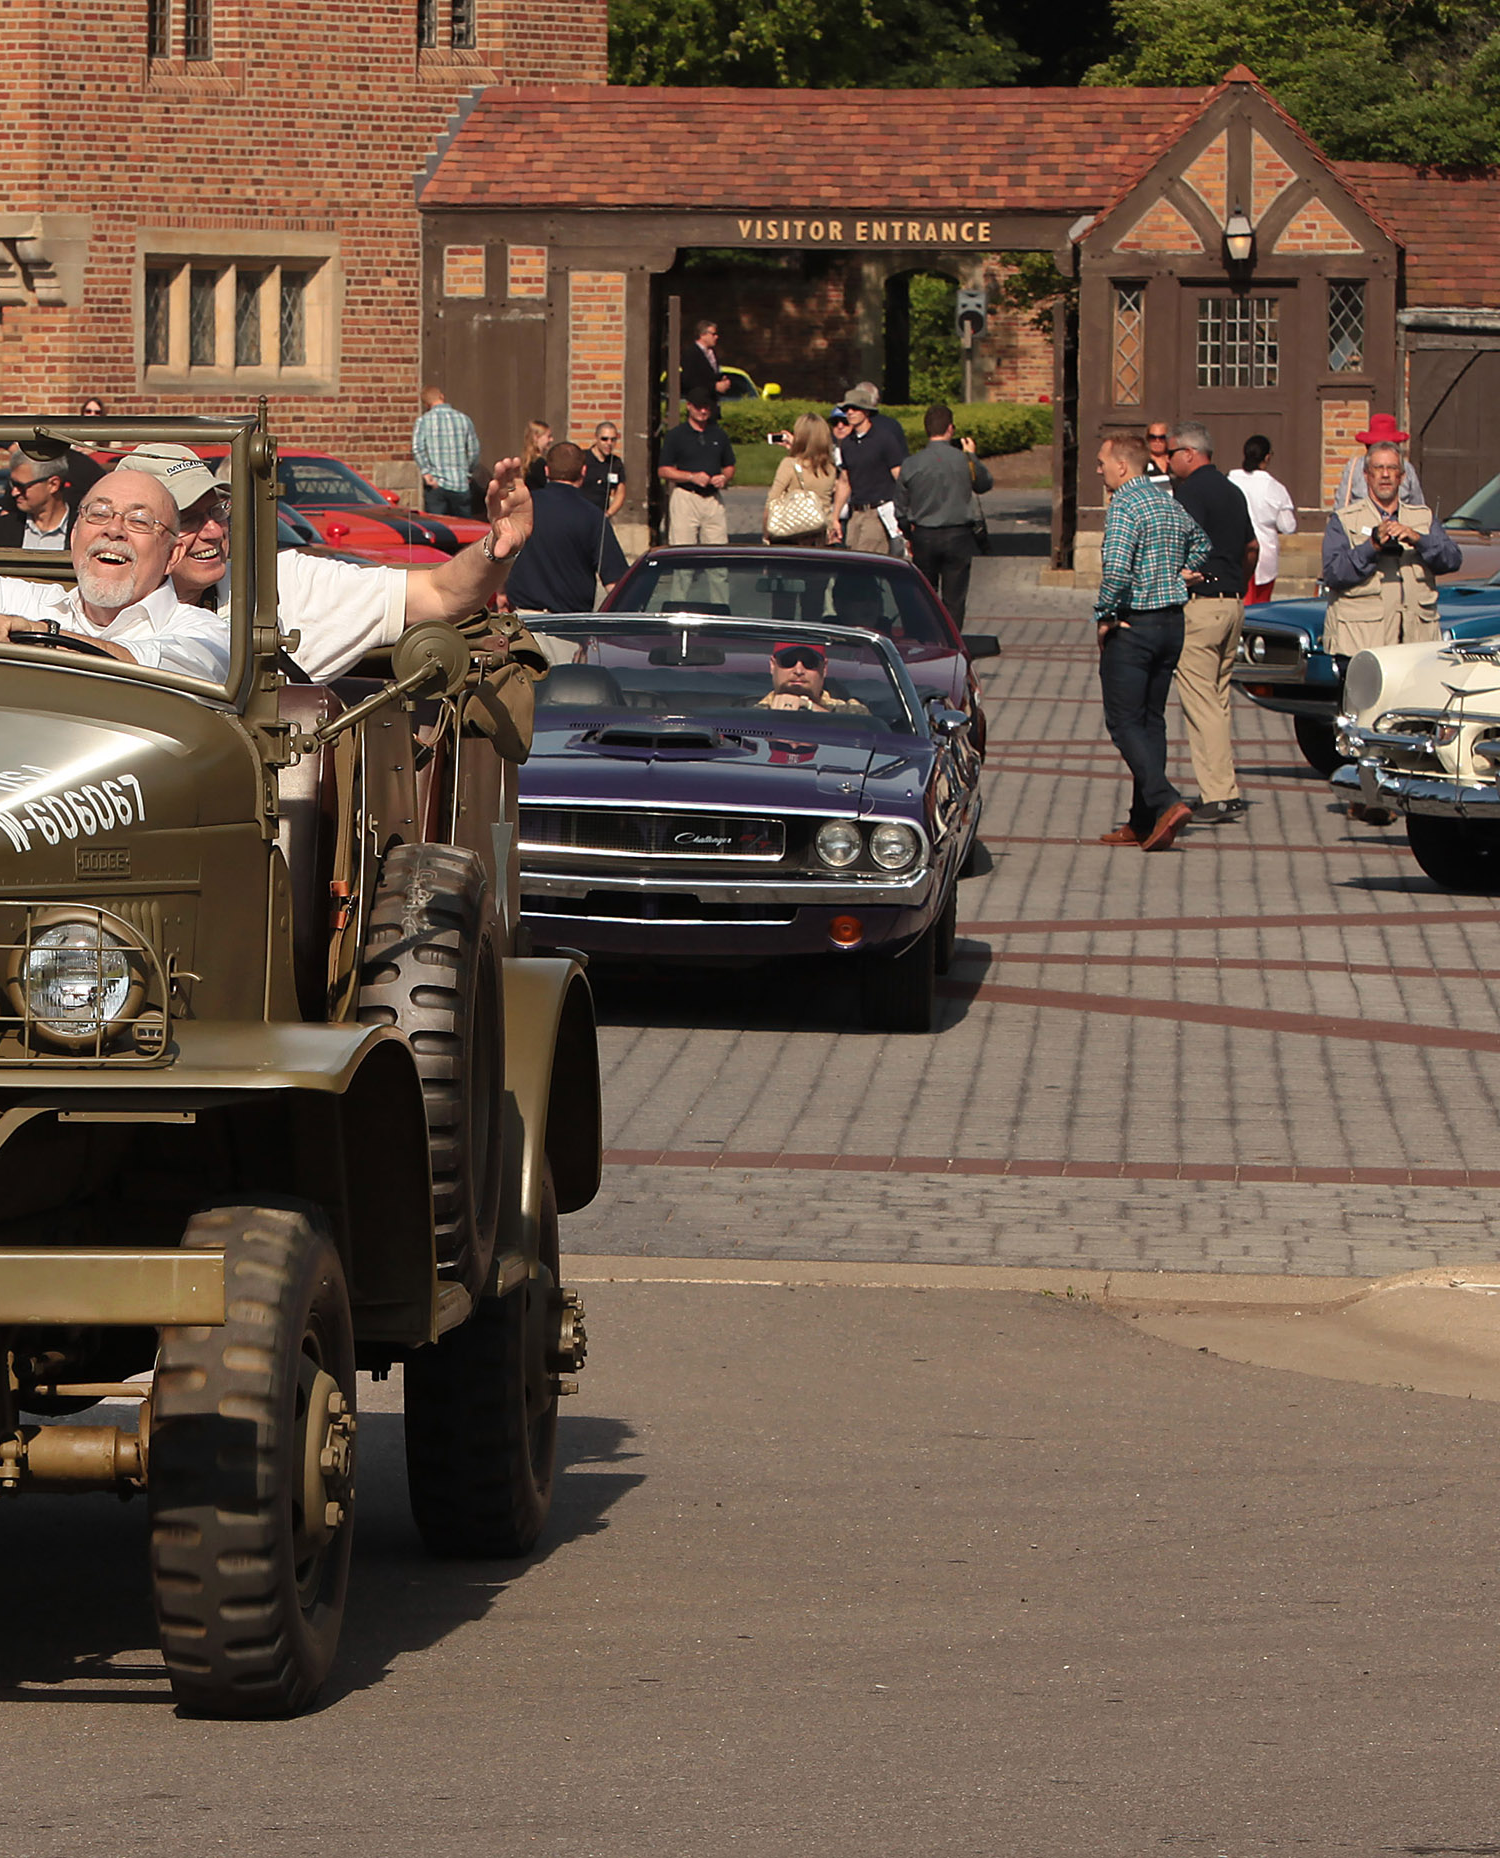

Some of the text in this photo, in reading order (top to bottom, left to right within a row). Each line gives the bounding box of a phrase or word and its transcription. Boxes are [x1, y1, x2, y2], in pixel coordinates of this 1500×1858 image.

[738, 220, 991, 242] VISITOR ENTRANCE
[80, 851, 126, 871] DODGE
